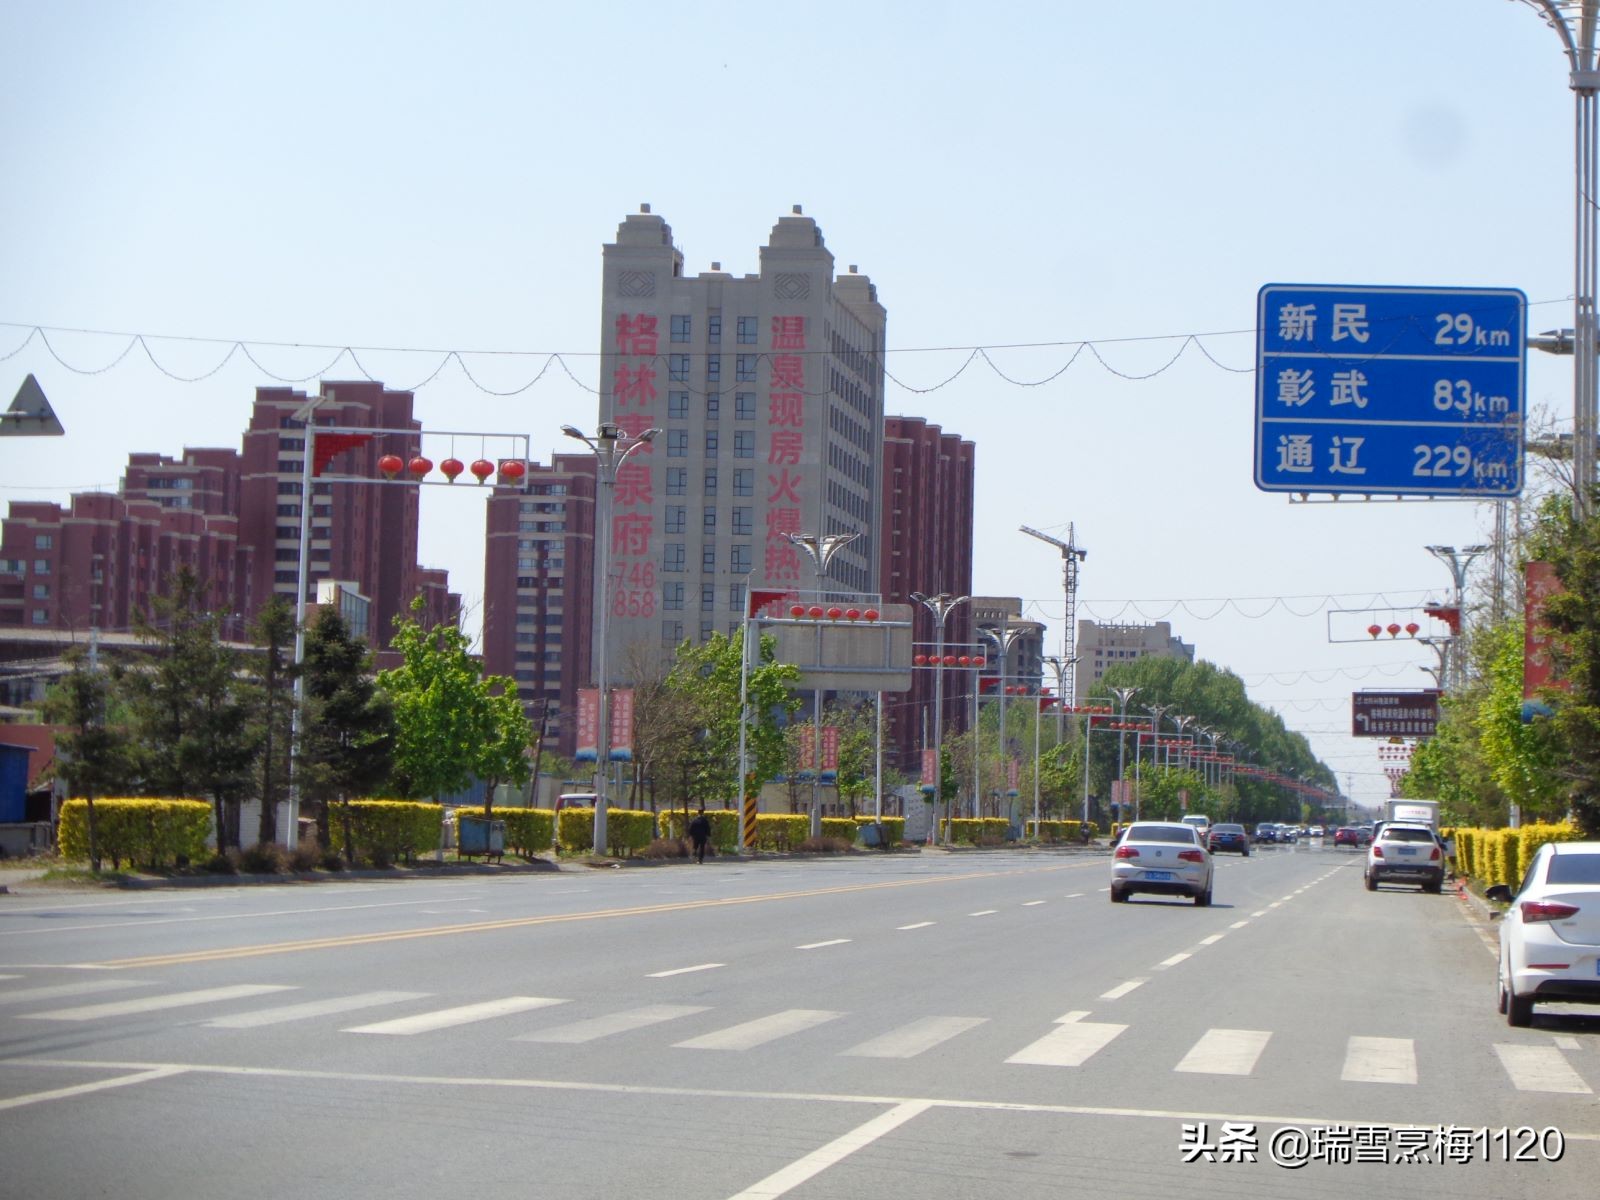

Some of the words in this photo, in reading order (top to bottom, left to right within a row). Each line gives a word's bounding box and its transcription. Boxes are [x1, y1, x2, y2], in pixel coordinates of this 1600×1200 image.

[1278, 303, 1370, 343] 新民
[1435, 313, 1510, 346] 29km
[1277, 368, 1368, 409] 彰武
[1433, 379, 1509, 412] 83km
[1276, 435, 1366, 474] 通辽
[1413, 445, 1508, 479] 229km
